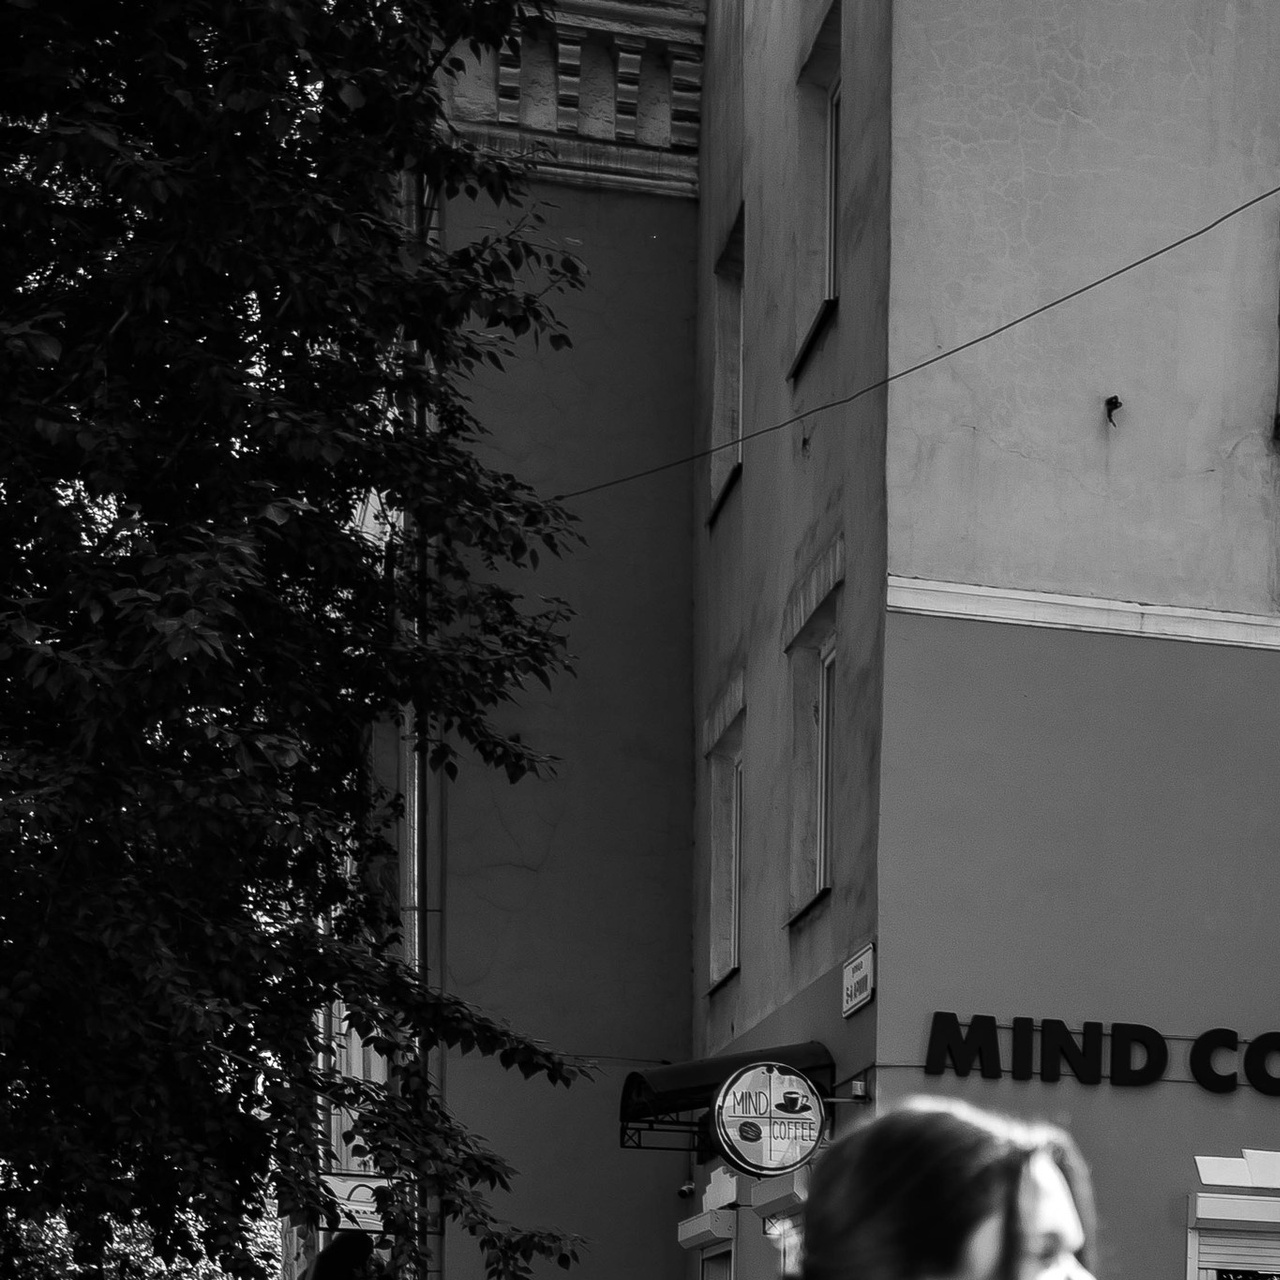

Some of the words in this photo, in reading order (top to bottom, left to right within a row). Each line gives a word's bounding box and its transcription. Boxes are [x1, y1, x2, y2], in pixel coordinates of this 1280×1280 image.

[924, 1011, 1168, 1087] MIND
[732, 1090, 769, 1116] MIND
[772, 1120, 816, 1142] COFFEE
